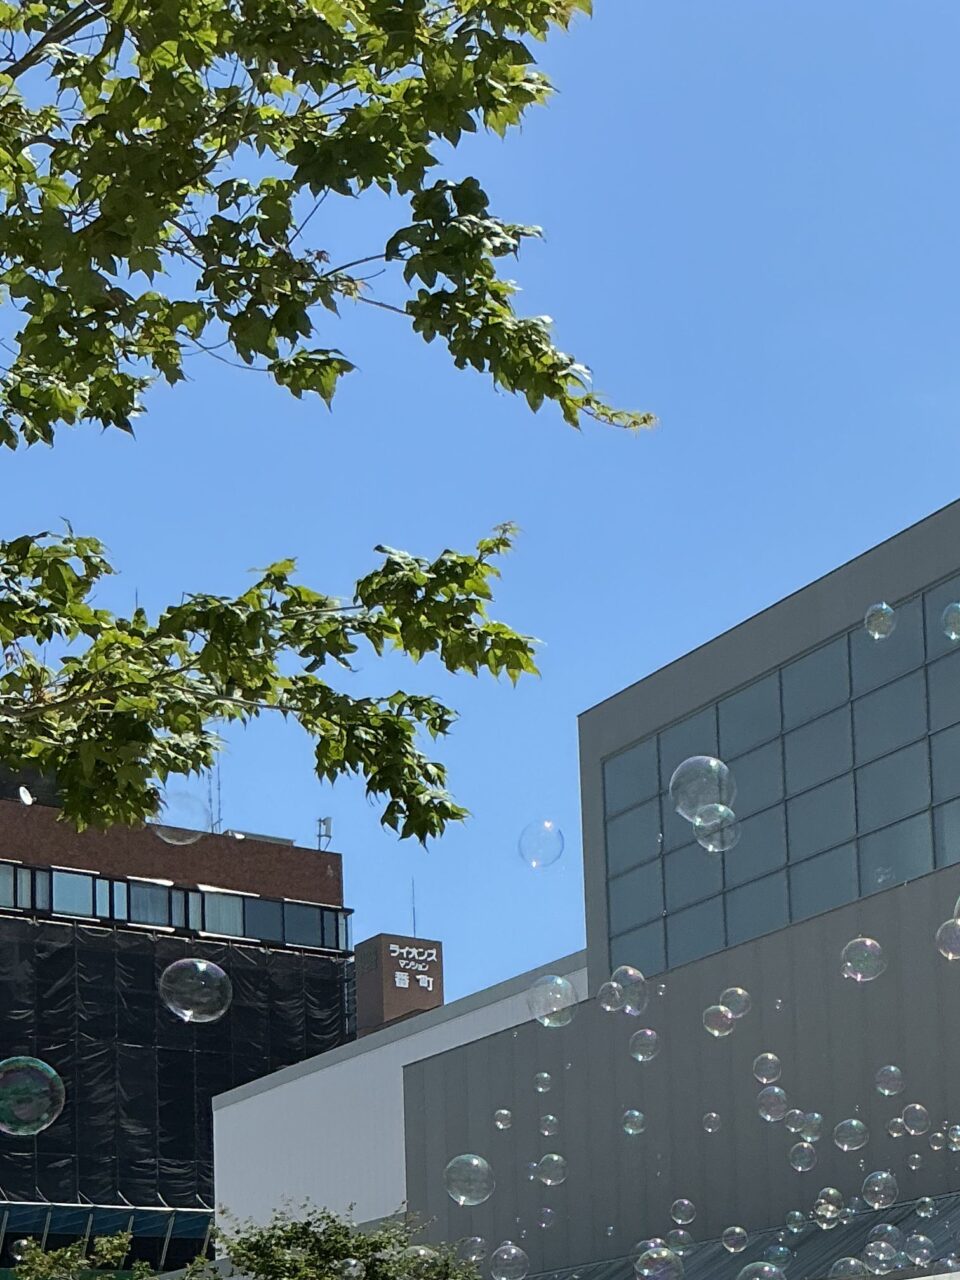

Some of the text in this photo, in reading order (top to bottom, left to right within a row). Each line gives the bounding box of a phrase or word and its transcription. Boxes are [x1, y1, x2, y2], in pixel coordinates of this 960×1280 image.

[389, 943, 437, 962] ライオンズ
[398, 959, 429, 971] マンション
